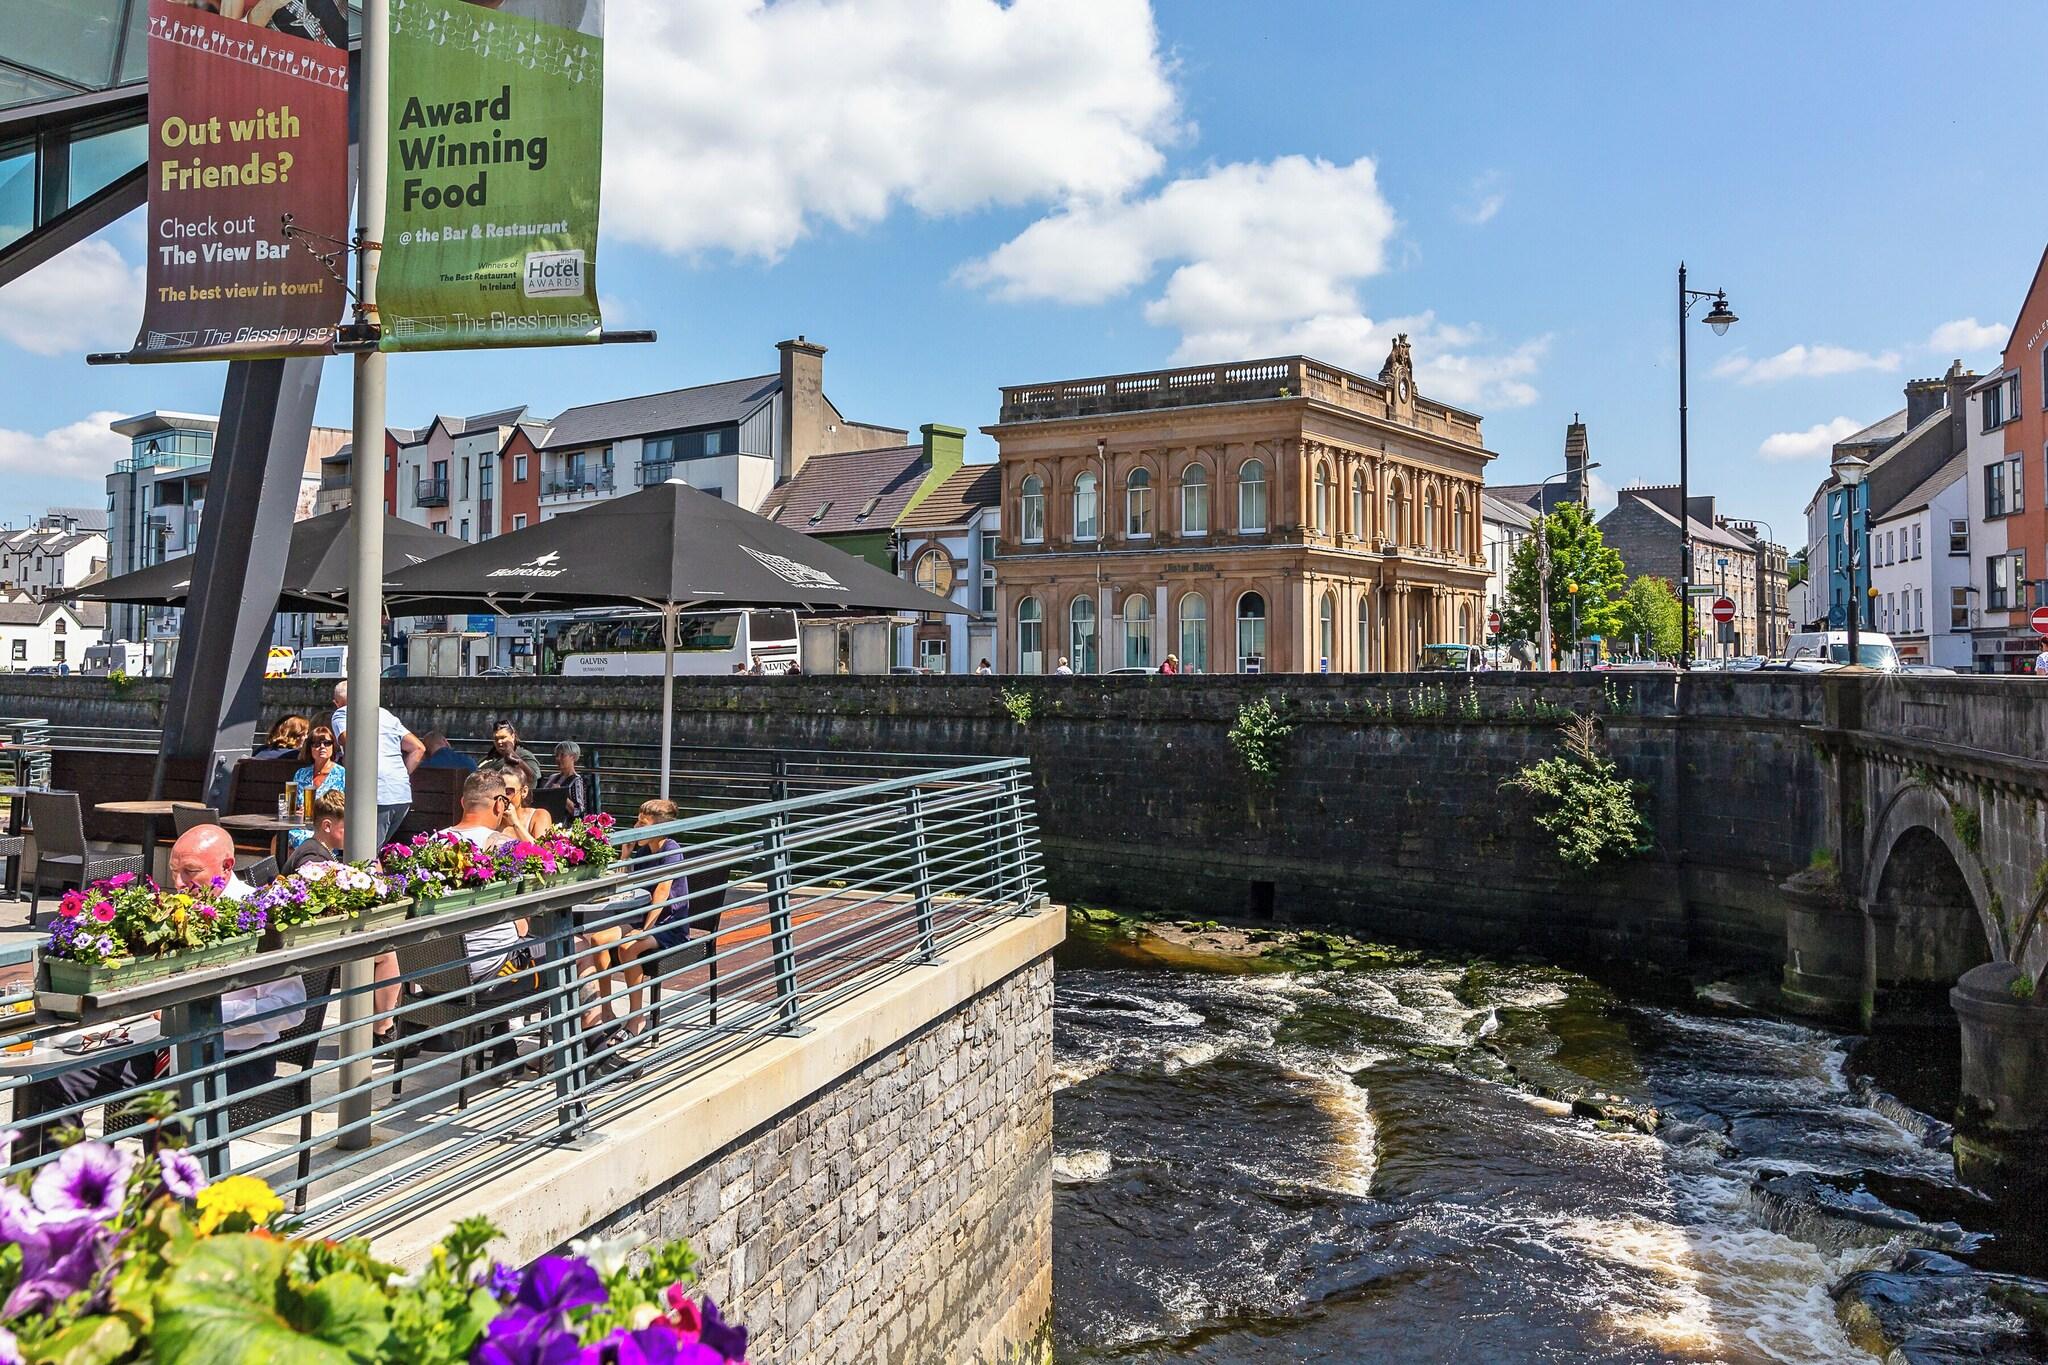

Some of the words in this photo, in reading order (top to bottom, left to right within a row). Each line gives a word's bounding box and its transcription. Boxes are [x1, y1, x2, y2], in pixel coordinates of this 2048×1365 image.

[399, 85, 511, 131] Award
[161, 116, 221, 148] Out
[228, 105, 300, 141] with
[399, 128, 548, 171] Winning
[162, 151, 294, 191] Friends?
[403, 171, 487, 212] Food
[160, 216, 218, 239] Check
[223, 216, 255, 235] out
[399, 231, 412, 245] @
[415, 227, 440, 243] the
[443, 226, 468, 241] Bar
[471, 224, 482, 239] &
[486, 219, 568, 239] Restaurant
[159, 244, 197, 266] The
[201, 241, 251, 263] View
[255, 240, 290, 260] Bar
[478, 262, 508, 270] Winners
[510, 260, 519, 268] of
[440, 274, 454, 282] The
[455, 272, 473, 281] Best
[474, 271, 517, 281] Restaurant
[529, 258, 580, 278] Hotel
[158, 286, 187, 302] The
[190, 284, 221, 301] best
[224, 282, 259, 298] view
[262, 281, 277, 297] in
[280, 278, 324, 296] town!
[479, 283, 488, 292] In
[488, 281, 517, 291] Ireland
[528, 277, 580, 288] AWARDS
[451, 312, 486, 333] The
[490, 309, 590, 332] Glasshouse
[203, 328, 232, 345] The
[234, 325, 328, 344] Glasshouse
[579, 657, 608, 665] GALVINS
